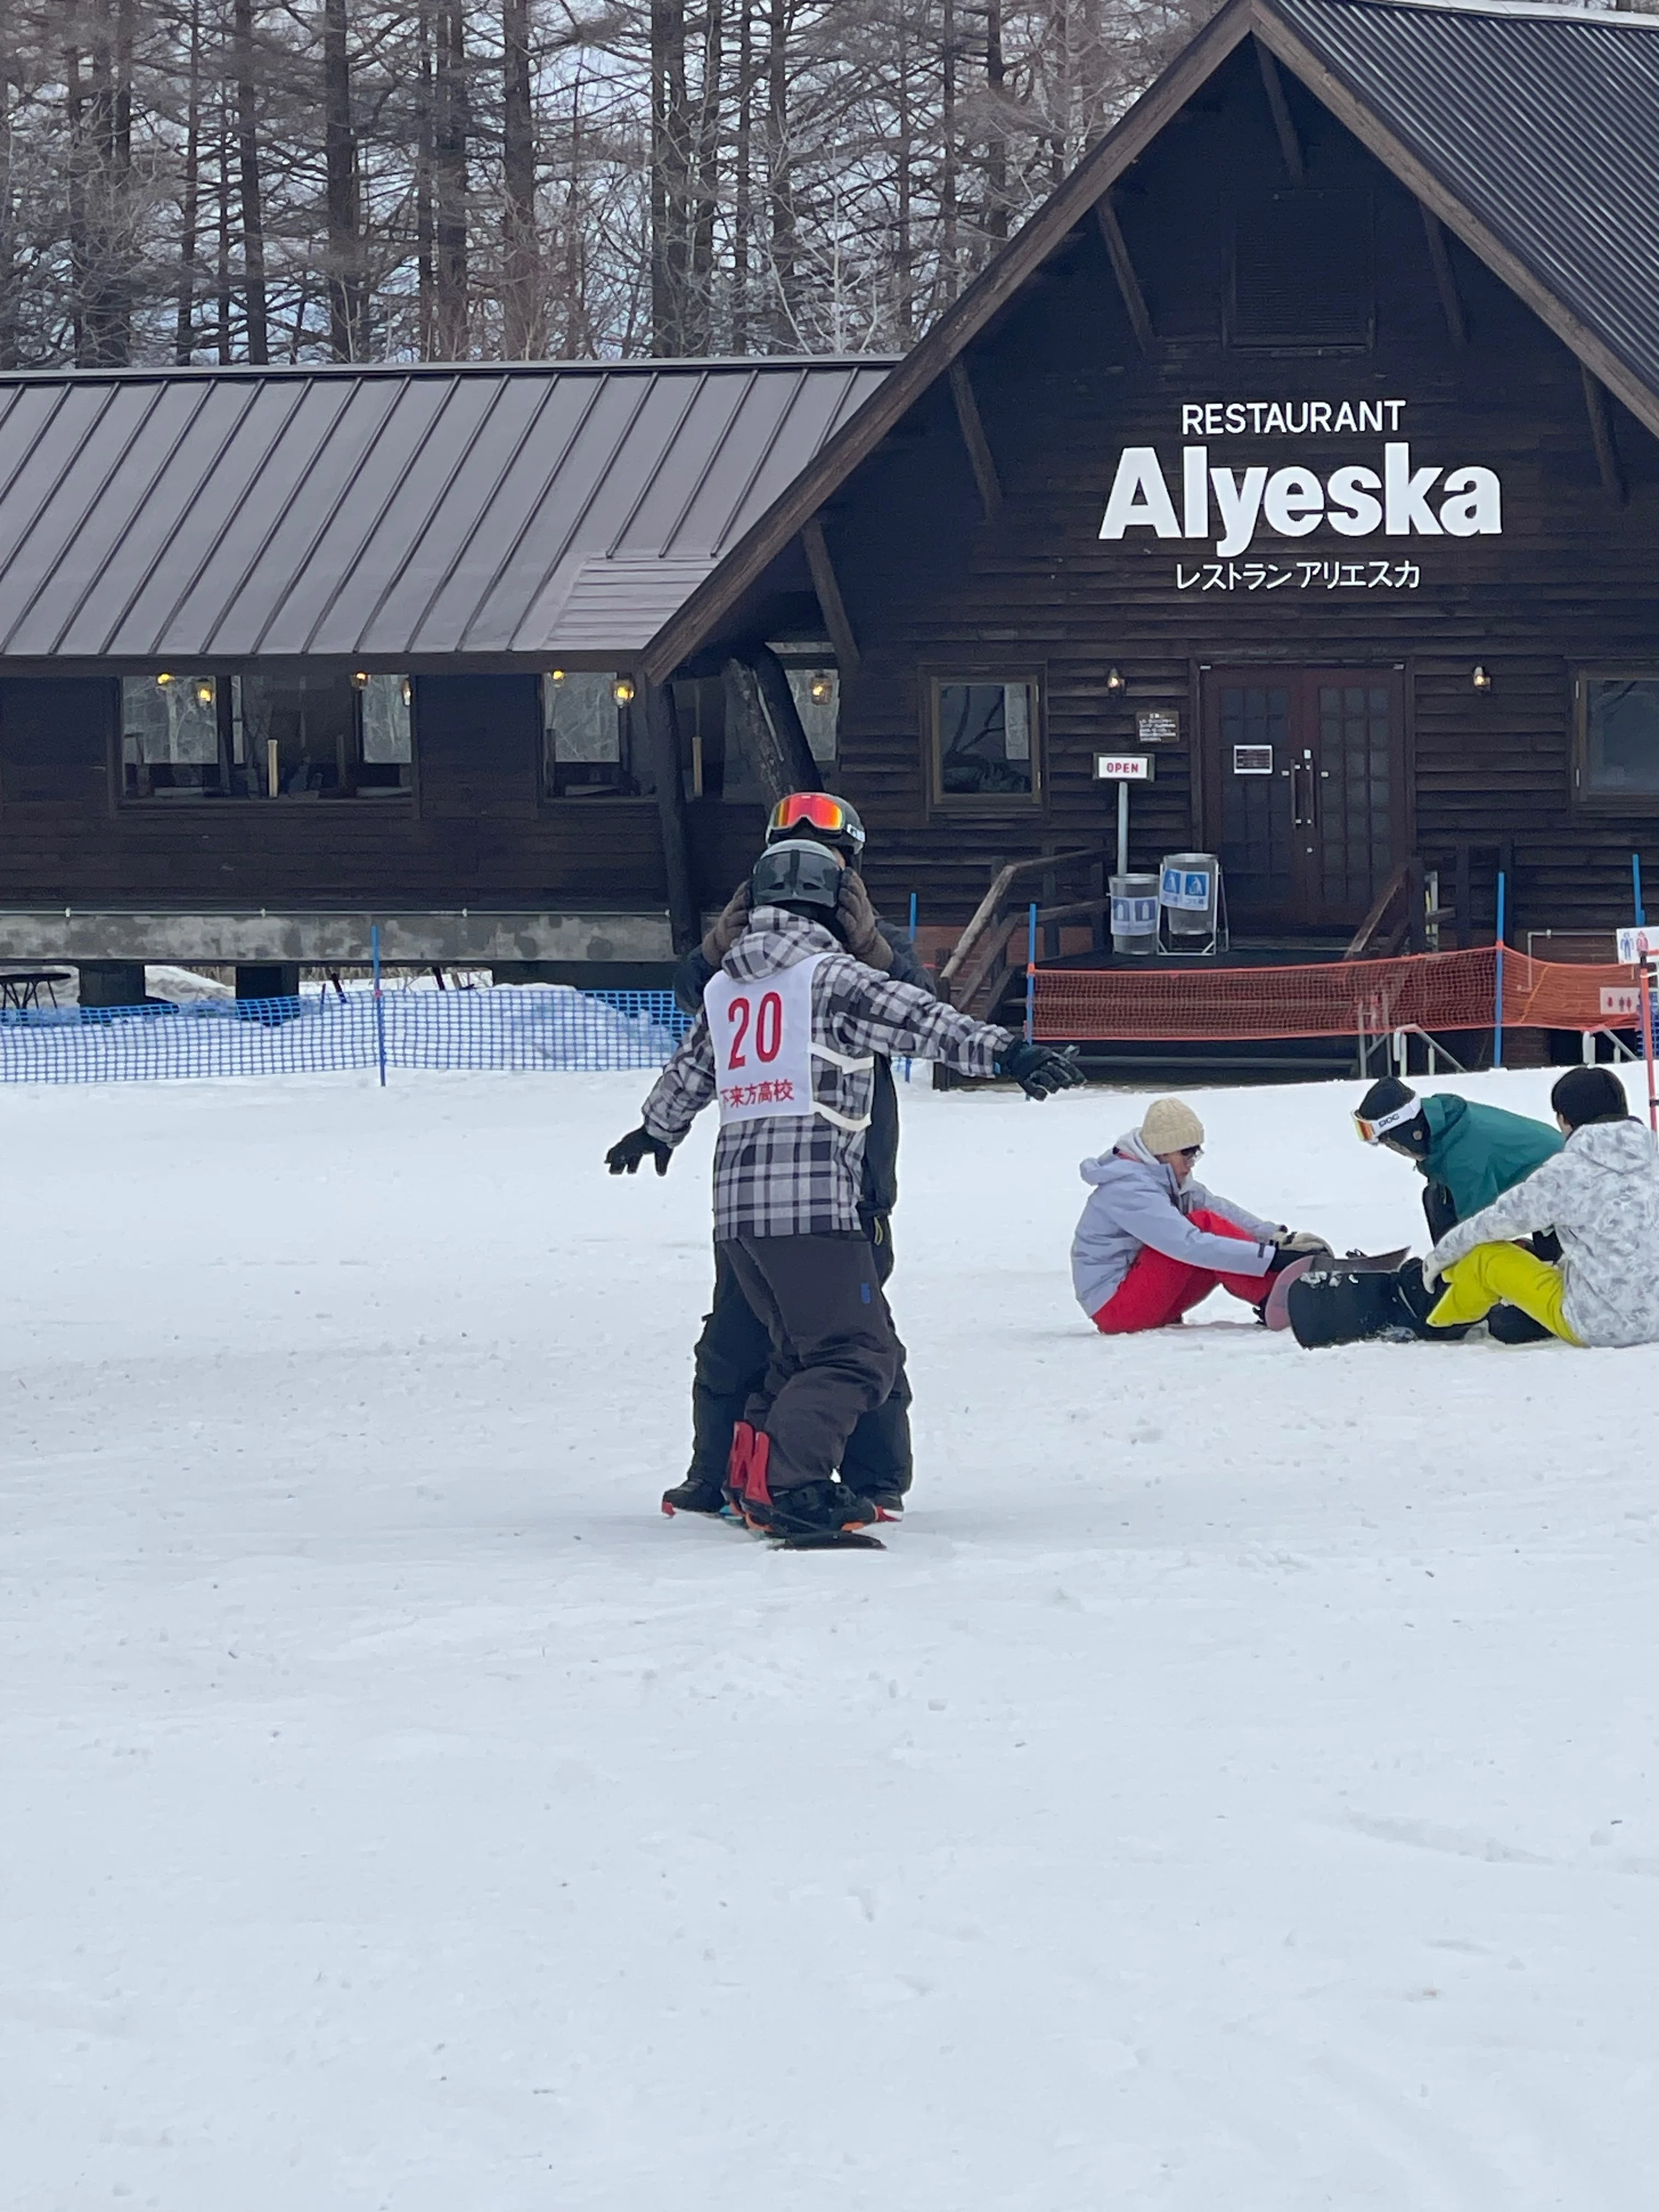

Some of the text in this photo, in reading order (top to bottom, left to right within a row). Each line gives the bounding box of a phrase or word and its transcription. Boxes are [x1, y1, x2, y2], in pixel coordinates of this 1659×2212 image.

[1182, 399, 1407, 435] RESTAURANT
[1098, 442, 1503, 557] Alyeska
[1176, 560, 1421, 591] レストラン アリエスカ
[1107, 762, 1139, 773] OPEN
[727, 991, 783, 1070] 20
